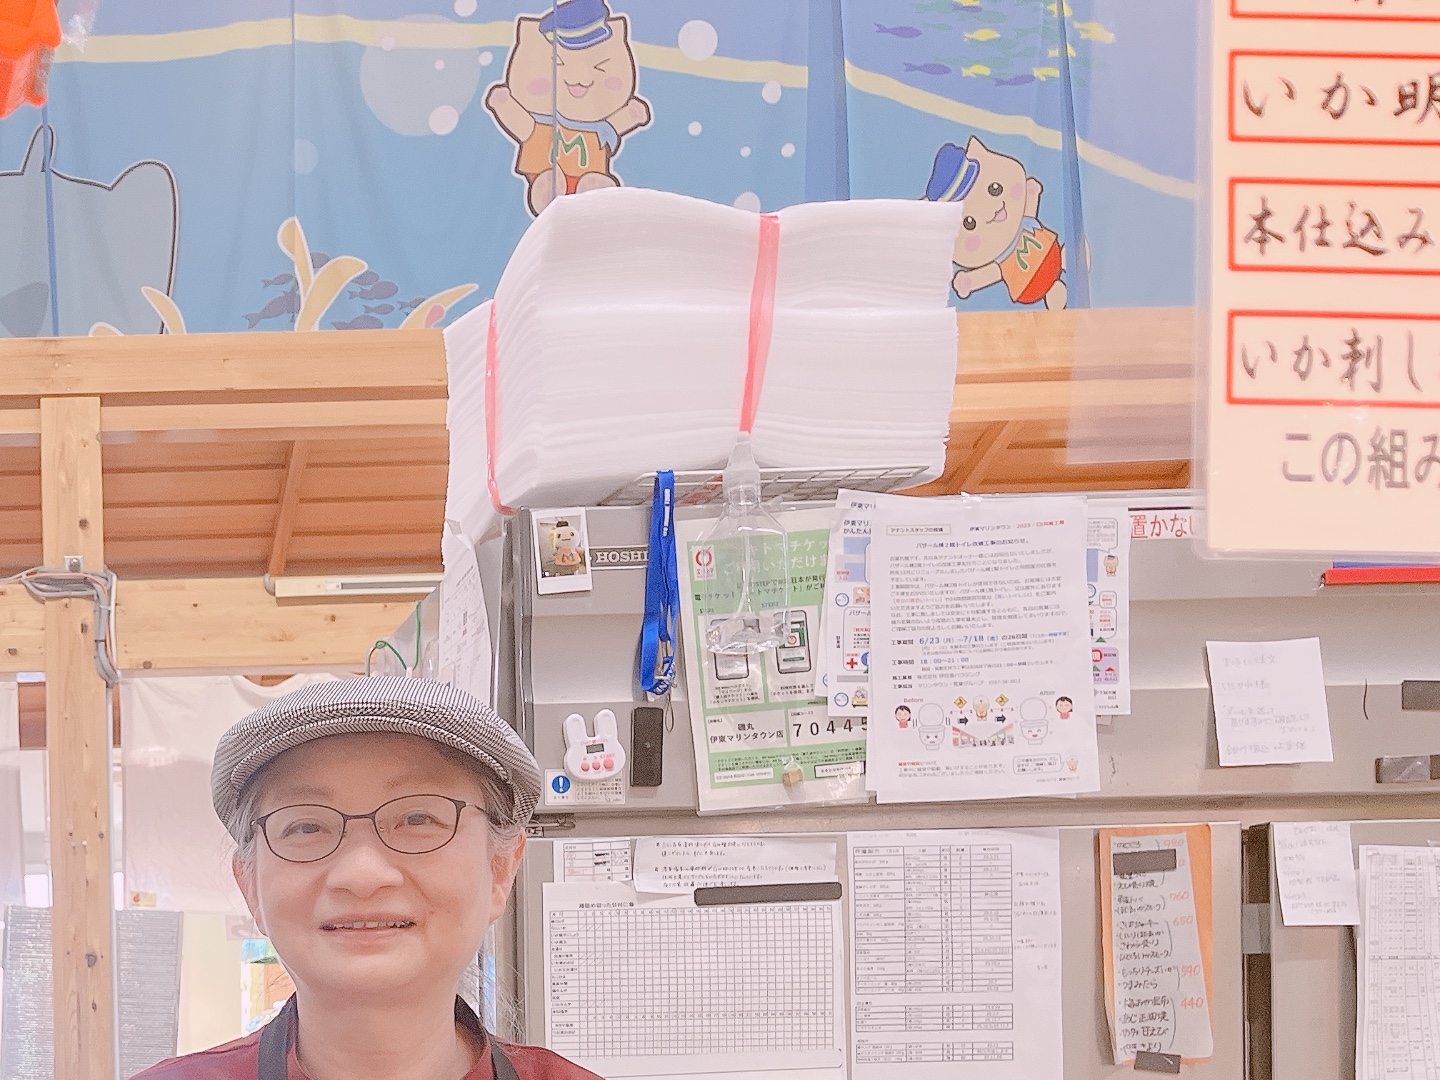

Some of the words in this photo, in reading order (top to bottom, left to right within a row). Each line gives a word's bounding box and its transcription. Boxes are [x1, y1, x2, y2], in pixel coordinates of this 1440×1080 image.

[1243, 196, 1436, 256] 本仕込み
[595, 550, 648, 564] HOSHI
